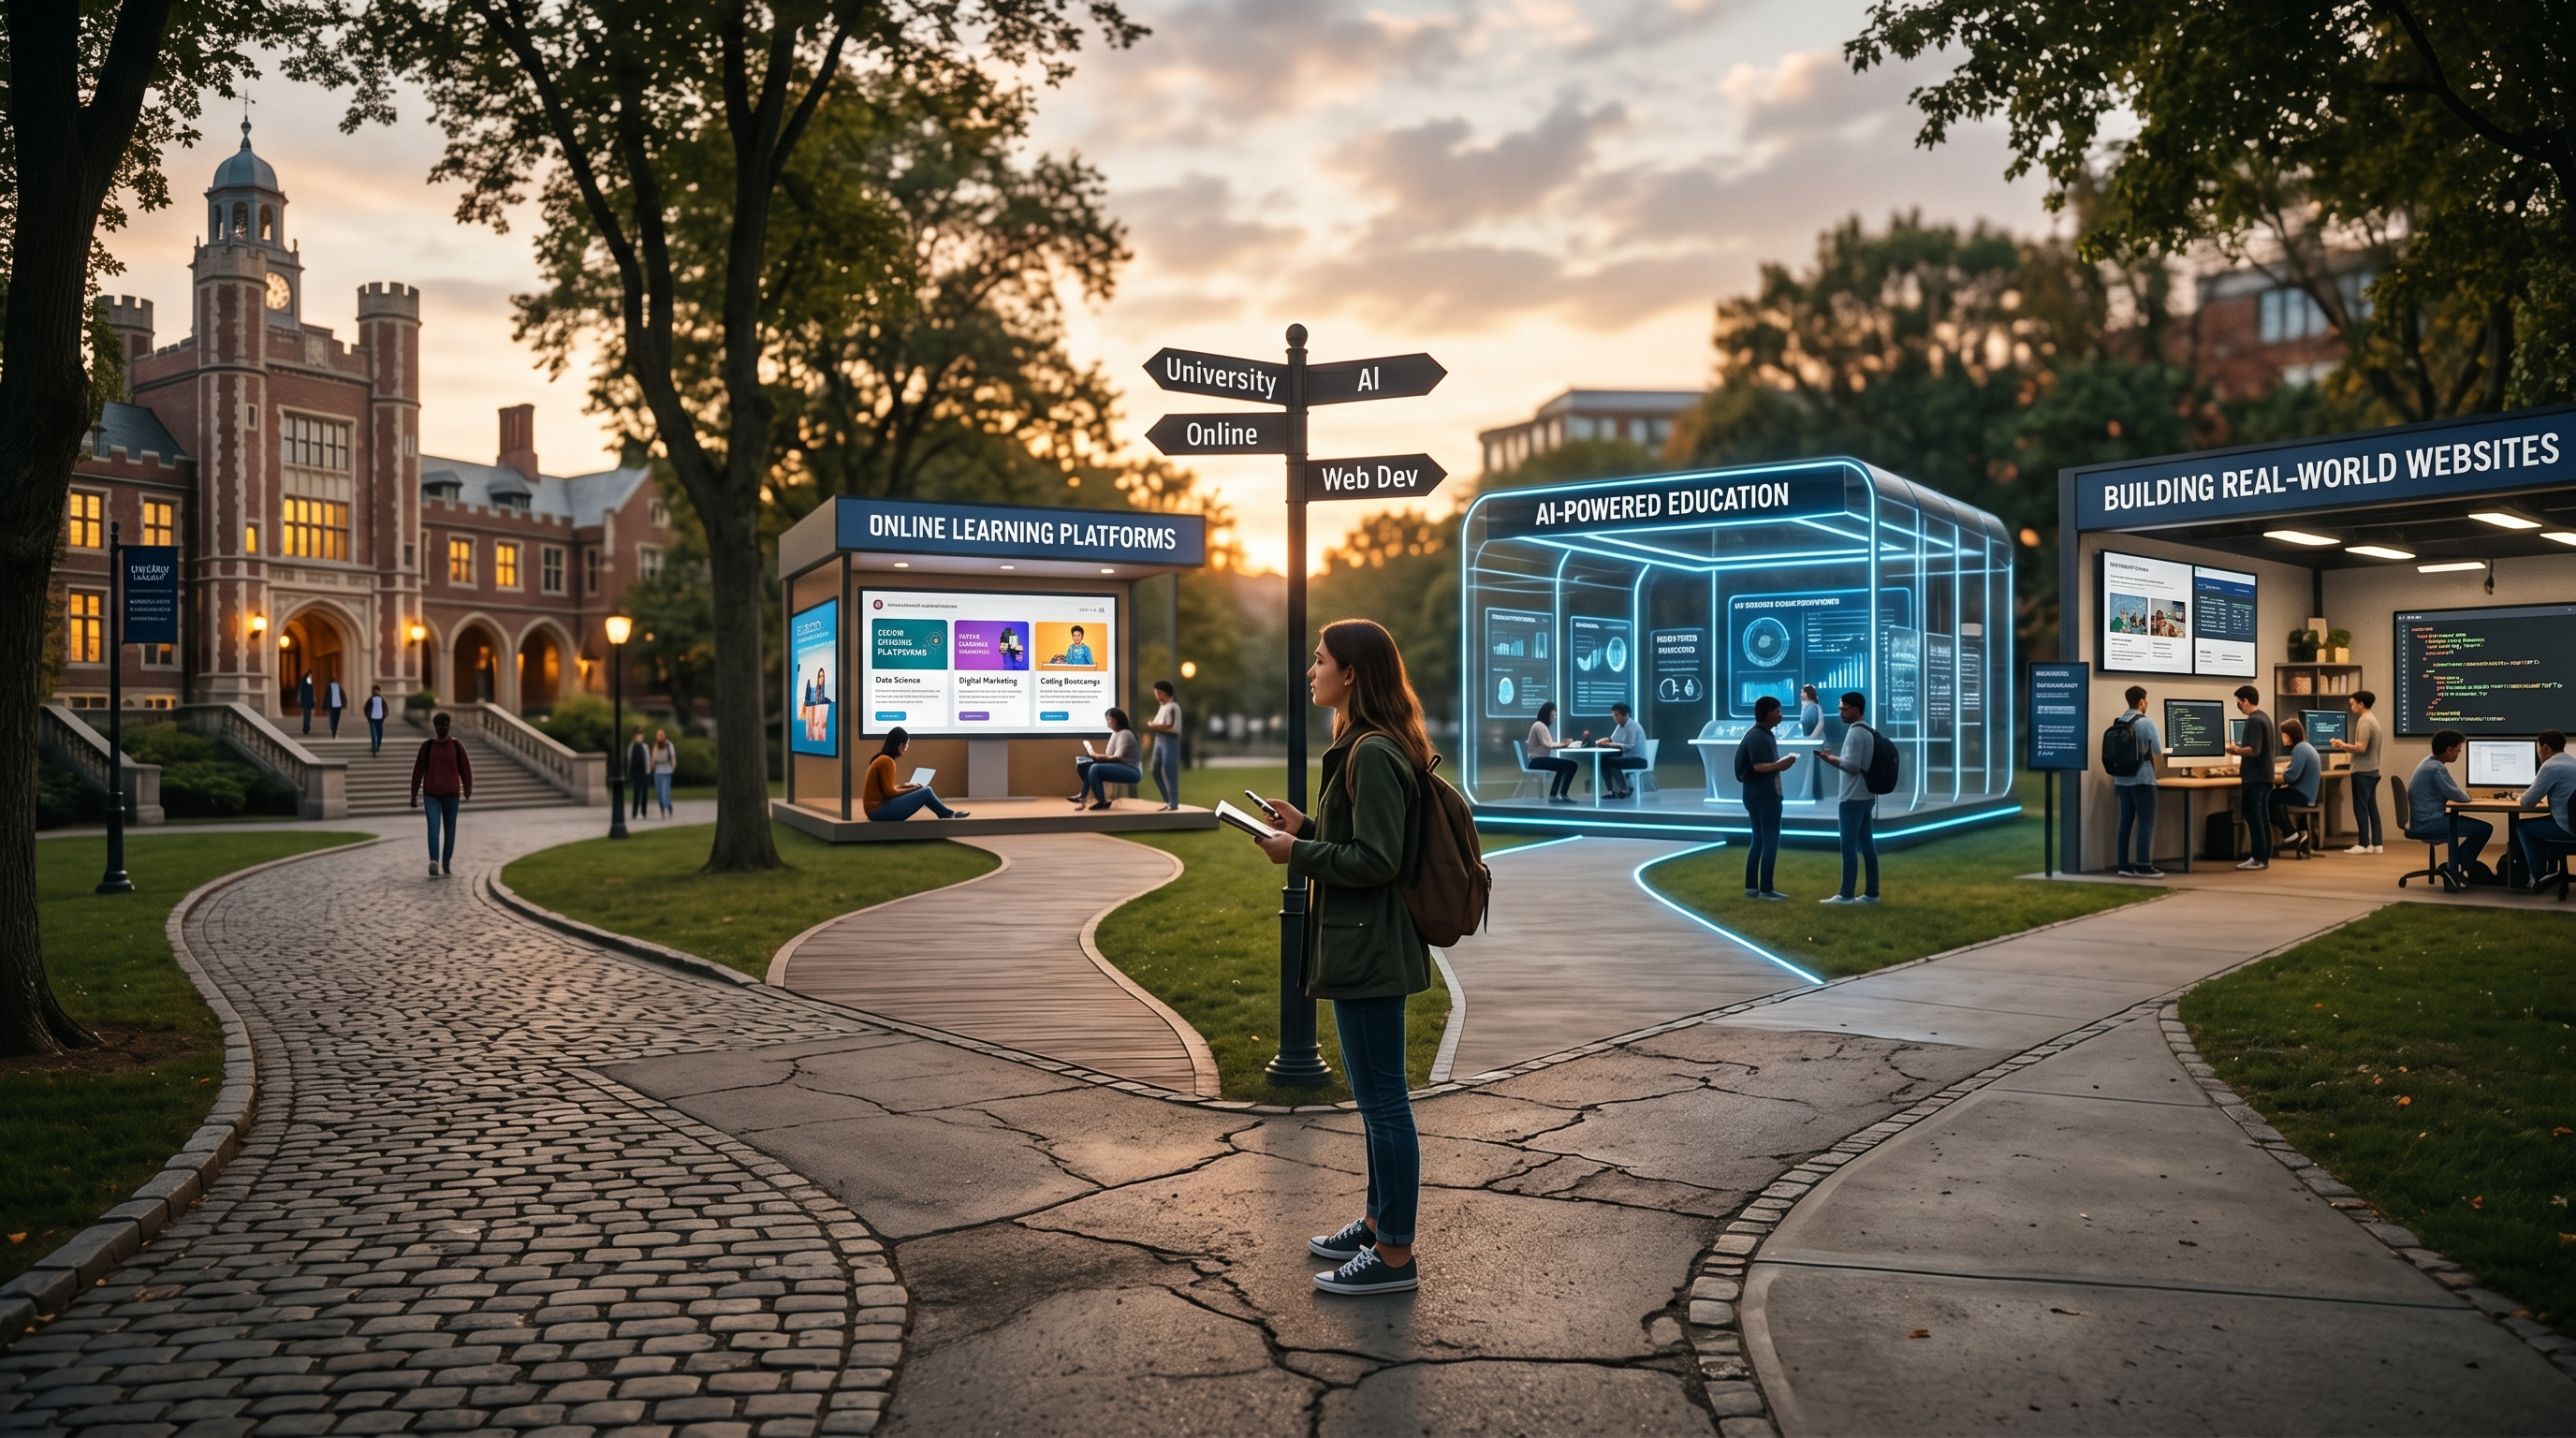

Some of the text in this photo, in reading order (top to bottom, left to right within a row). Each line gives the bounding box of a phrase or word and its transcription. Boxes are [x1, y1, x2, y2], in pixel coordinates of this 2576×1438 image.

[1166, 357, 1277, 400] University
[1357, 366, 1380, 391] AI
[1186, 422, 1258, 446] Online
[1322, 465, 1418, 491] Web Dev
[2104, 432, 2560, 512] BUILDING REAL-WORLD WEBSITES
[1535, 482, 1789, 525] AI-POWERED EDUCATION
[870, 514, 1177, 550] ONLINE LEARNING PLATFORMS
[894, 676, 921, 684] Science
[959, 677, 1017, 686] Digital Marketing
